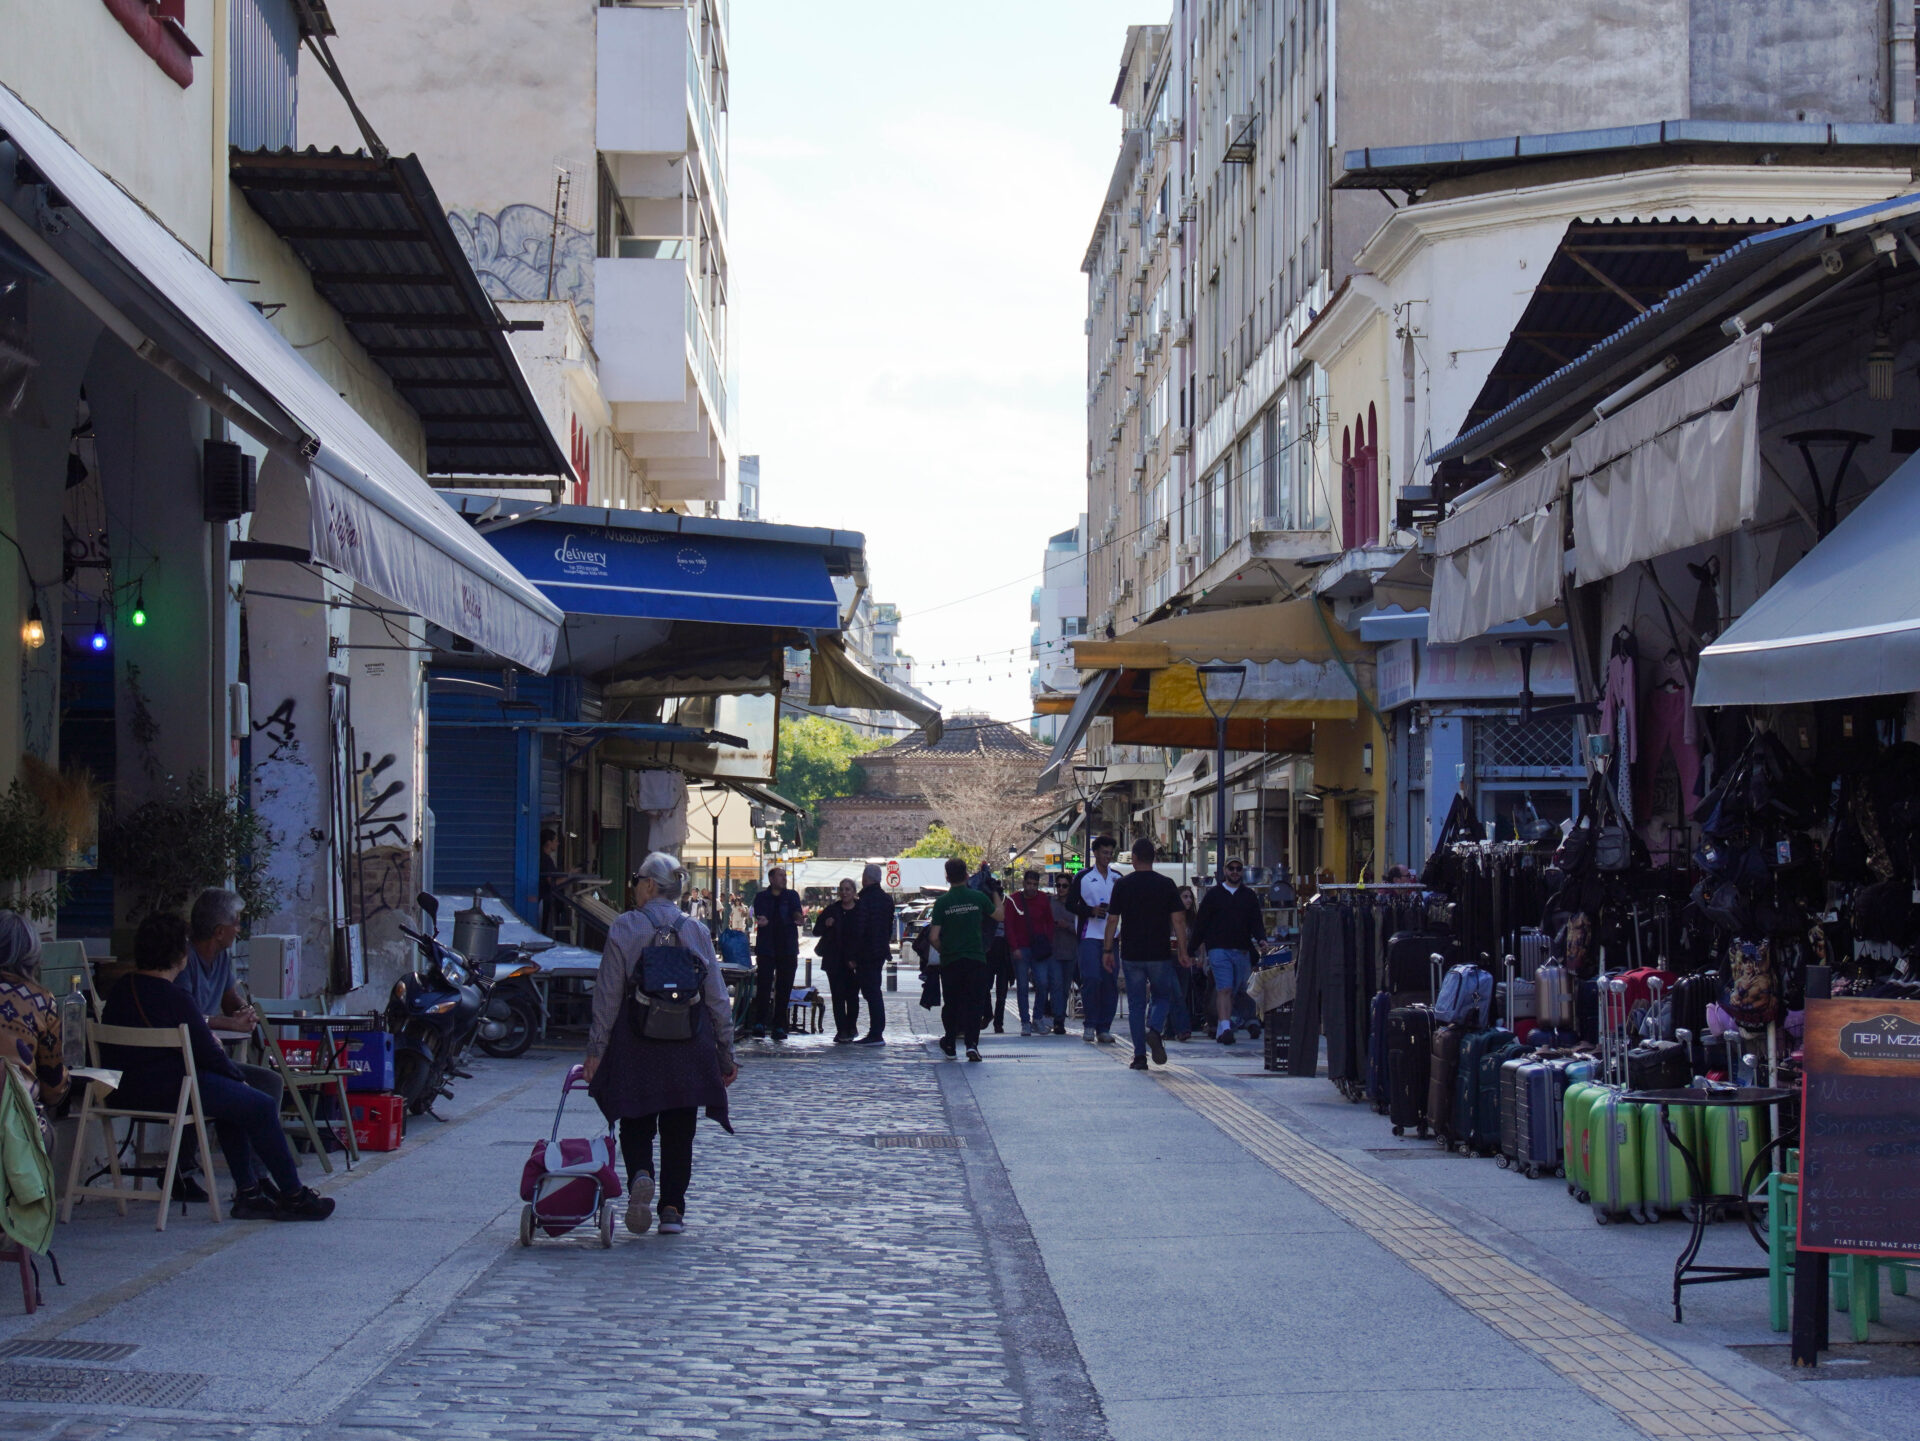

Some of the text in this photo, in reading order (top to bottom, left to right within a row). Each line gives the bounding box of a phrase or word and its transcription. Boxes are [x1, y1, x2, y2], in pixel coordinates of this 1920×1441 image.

[555, 534, 607, 567] delivery
[887, 864, 899, 872] STOP
[1853, 1032, 1881, 1044] ΠΕΡΙ
[1834, 1238, 1856, 1246] ΓΙΑΤΙ
[1880, 1241, 1899, 1249] ΜΑΣ
